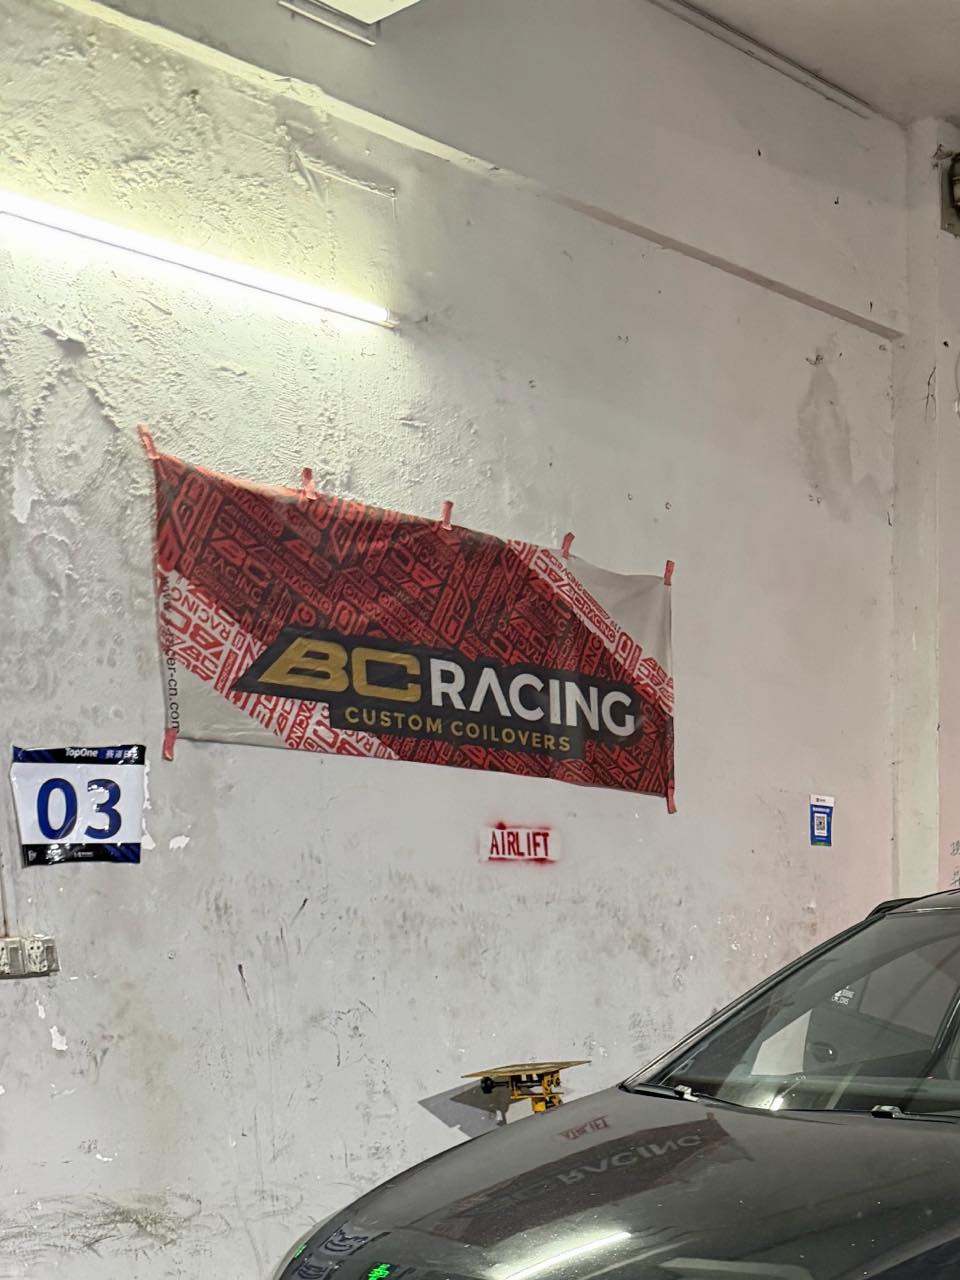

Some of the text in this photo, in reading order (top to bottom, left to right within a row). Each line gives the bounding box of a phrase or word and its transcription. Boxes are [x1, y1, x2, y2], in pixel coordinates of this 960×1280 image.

[345, 706, 571, 752] CUSTOM COILOVERS
[65, 747, 98, 759] TopOne
[37, 778, 122, 840] 03
[490, 830, 549, 857] AIRLIFT
